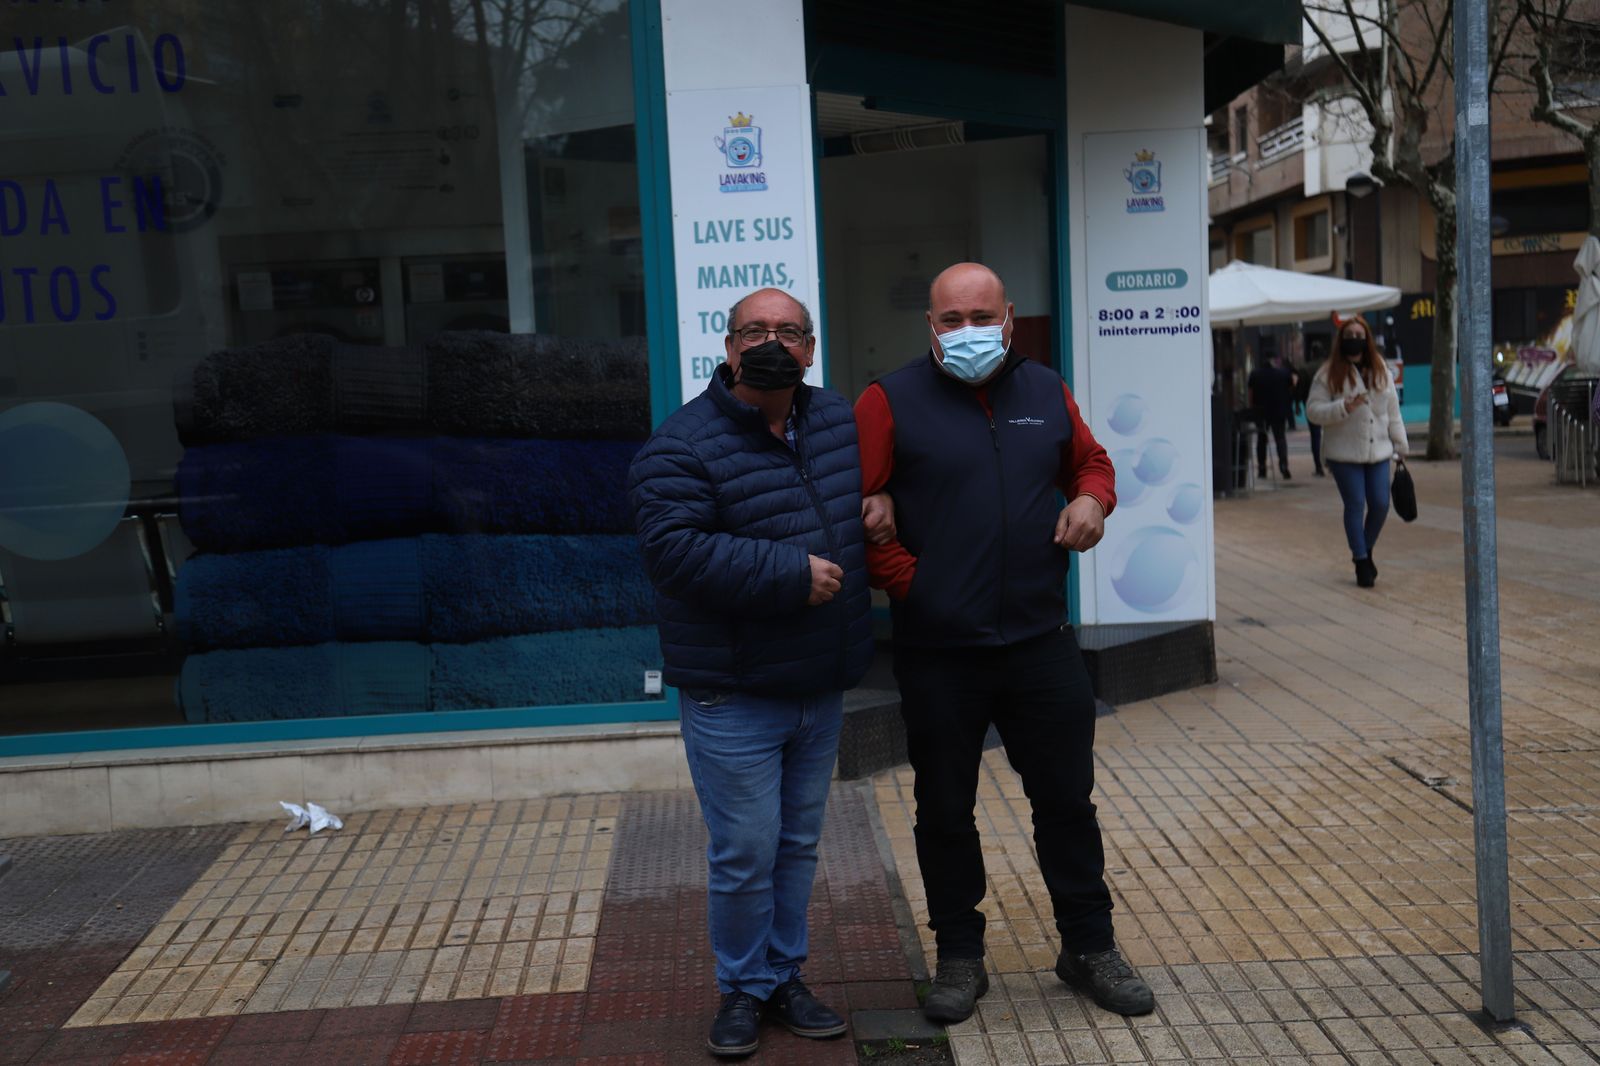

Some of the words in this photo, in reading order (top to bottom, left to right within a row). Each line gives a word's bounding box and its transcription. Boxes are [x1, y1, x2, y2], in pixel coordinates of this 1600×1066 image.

[0, 33, 186, 96] VICIO
[719, 172, 766, 187] LAVAKING
[99, 176, 168, 233] EN
[693, 219, 745, 244] LAVE
[752, 216, 794, 243] SUS
[697, 262, 794, 290] MANTAS,
[1116, 273, 1177, 289] HORARIO
[0, 264, 117, 323] TOS
[698, 311, 726, 335] TO
[1098, 308, 1134, 322] 8:00
[1139, 310, 1149, 320] a
[1098, 323, 1201, 338] ininterrumpido
